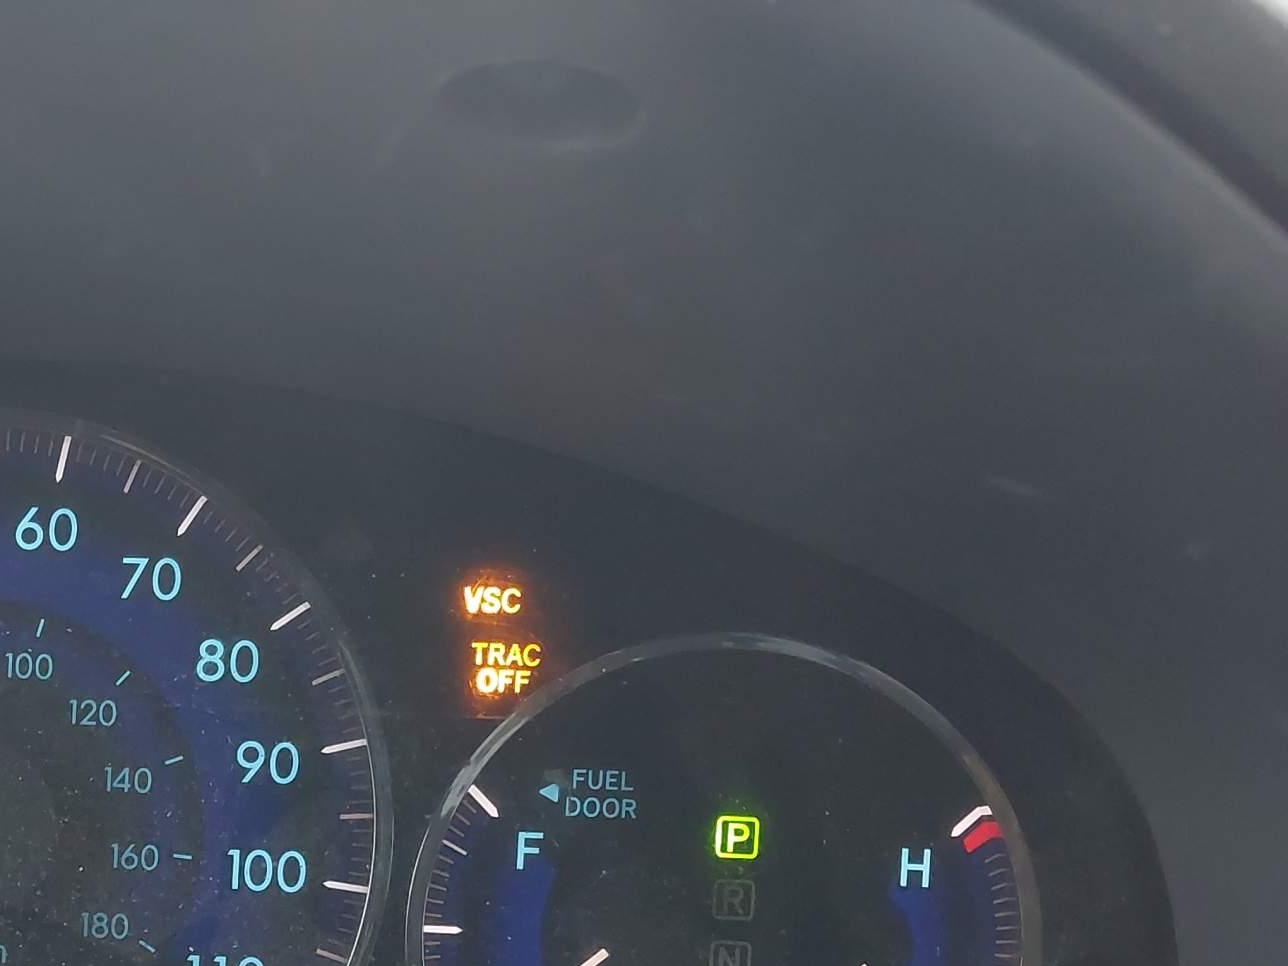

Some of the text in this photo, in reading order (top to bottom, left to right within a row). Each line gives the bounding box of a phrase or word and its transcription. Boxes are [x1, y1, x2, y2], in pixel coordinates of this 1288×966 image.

[16, 507, 78, 551] 60
[120, 557, 181, 600] 70
[463, 586, 522, 615] VSC
[5, 653, 53, 679] 100
[195, 639, 258, 683] 80
[472, 642, 542, 667] TRAC
[476, 667, 532, 693] OFF
[69, 699, 117, 727] 120
[236, 741, 299, 785] 90
[104, 767, 152, 794] 140
[572, 769, 634, 792] FUEL
[565, 796, 637, 820] DOOR
[516, 832, 544, 870] F
[726, 822, 751, 853] P
[112, 844, 159, 871] 160
[227, 849, 307, 893] 100
[900, 848, 932, 888] H
[723, 883, 745, 916] R
[81, 912, 129, 940] 180
